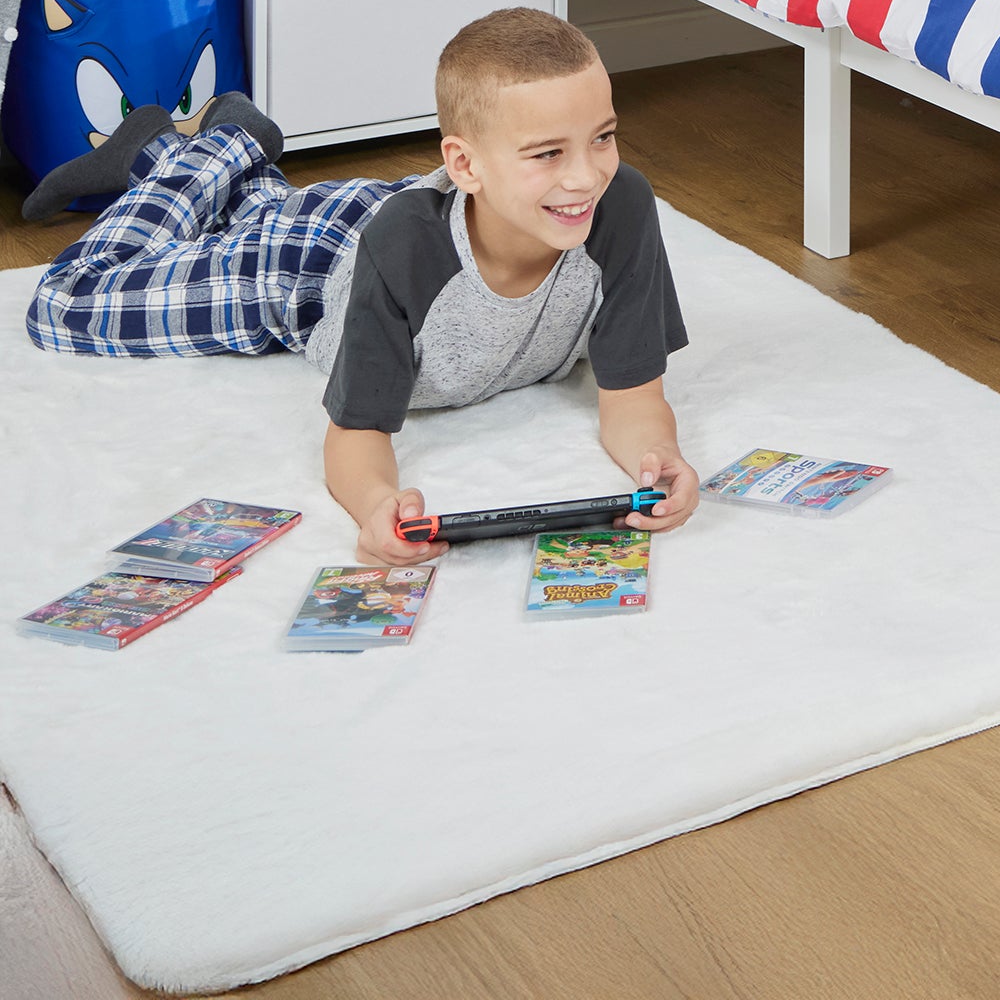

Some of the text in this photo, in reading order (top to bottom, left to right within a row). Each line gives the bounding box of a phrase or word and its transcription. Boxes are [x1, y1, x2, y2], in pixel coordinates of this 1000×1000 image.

[760, 460, 817, 495] Sports
[546, 583, 617, 594] Crossing
[548, 589, 612, 601] Animal
